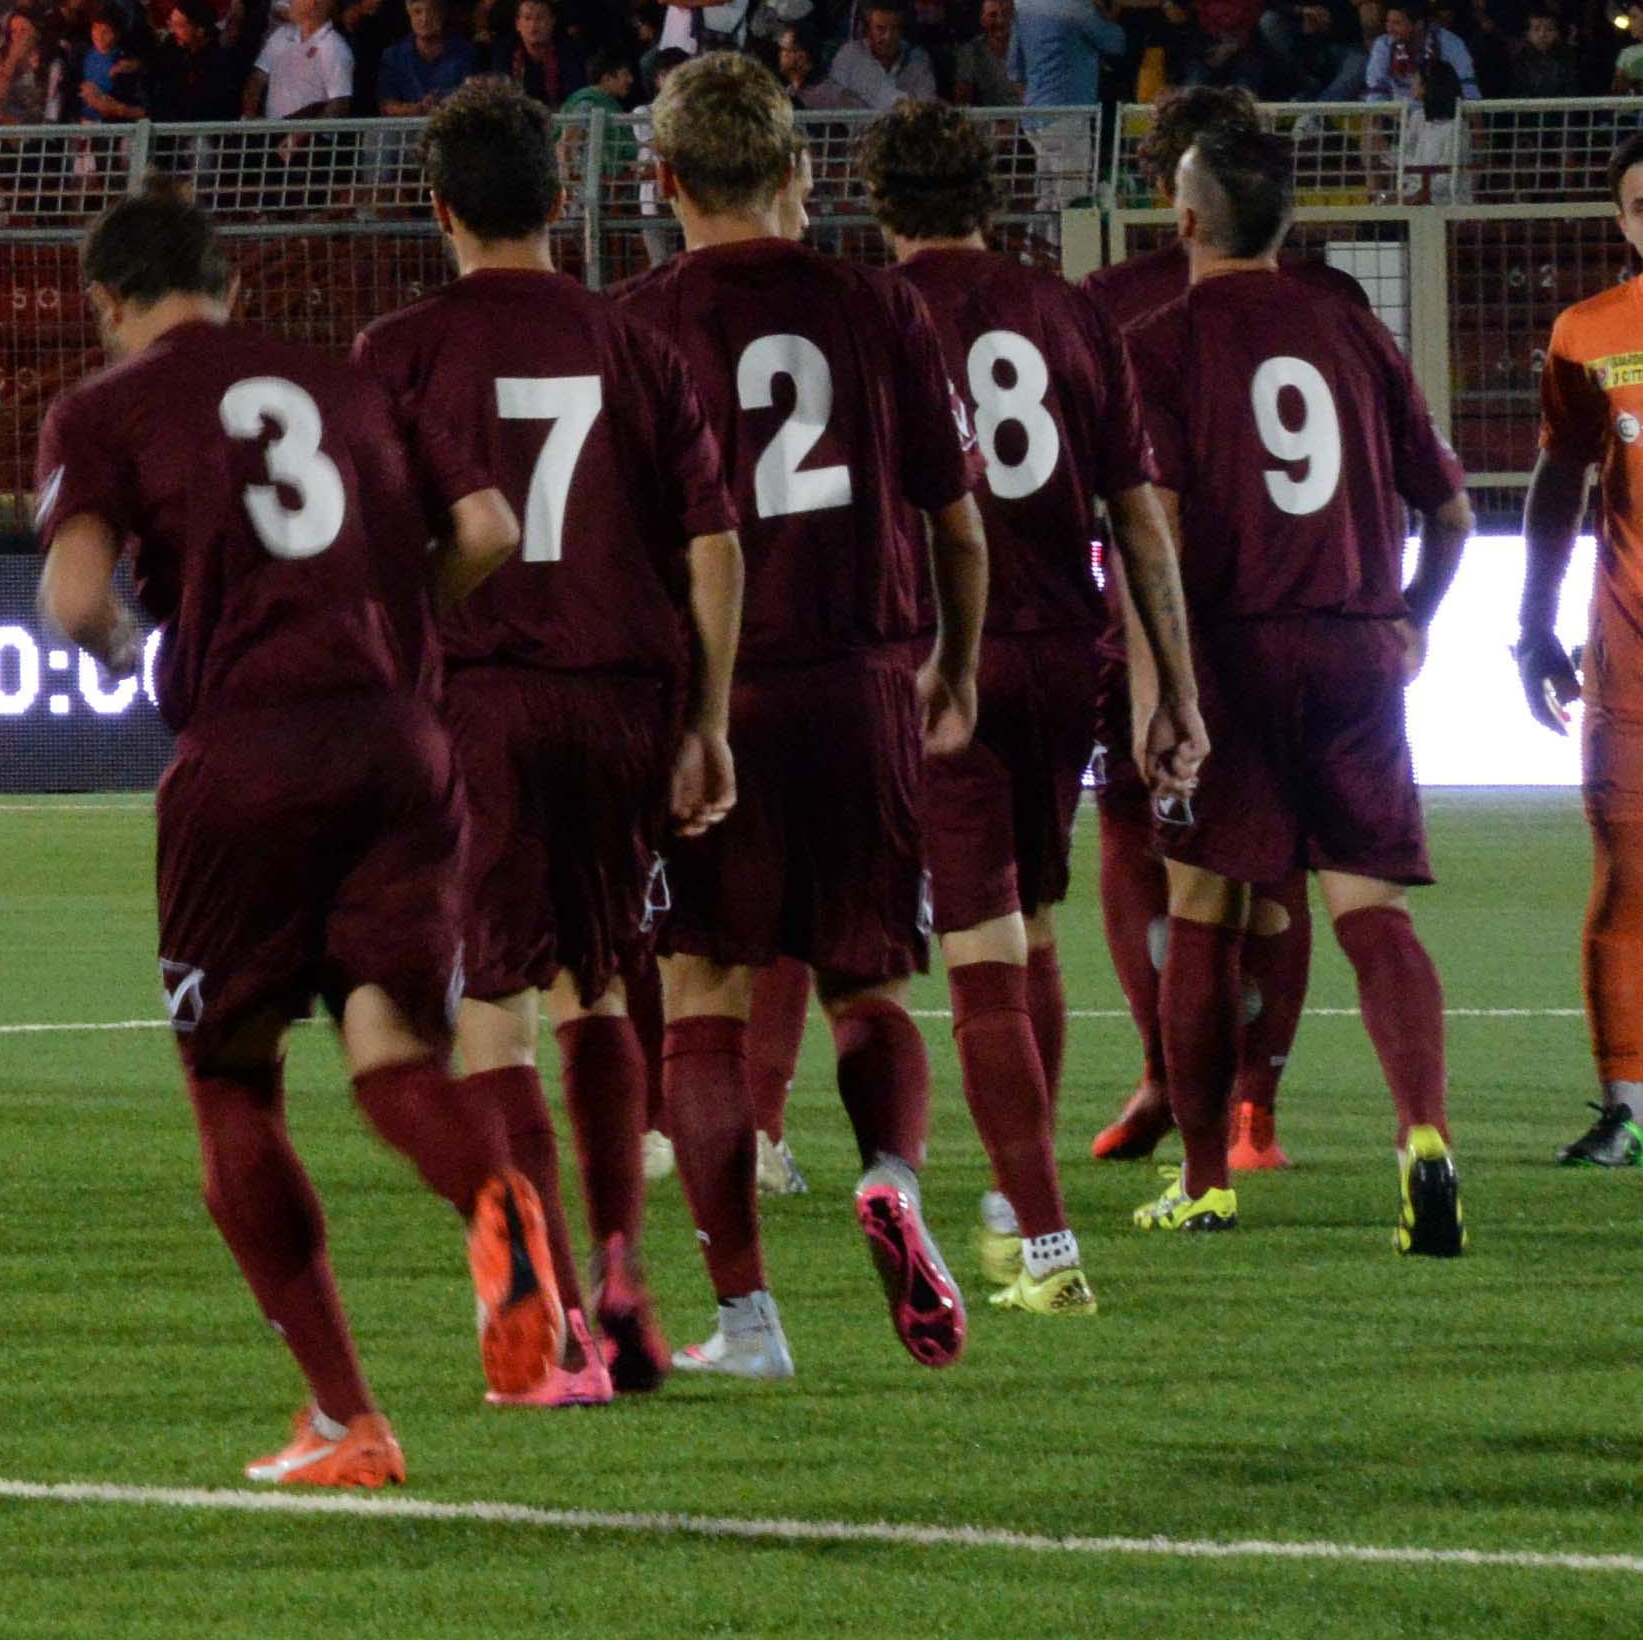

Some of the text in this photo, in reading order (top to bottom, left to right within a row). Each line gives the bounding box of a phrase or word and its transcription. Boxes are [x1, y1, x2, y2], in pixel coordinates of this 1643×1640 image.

[219, 376, 345, 559] 3
[496, 375, 602, 562] 7
[737, 334, 852, 519] 2
[967, 331, 1059, 500] 8
[1252, 356, 1341, 516] 9
